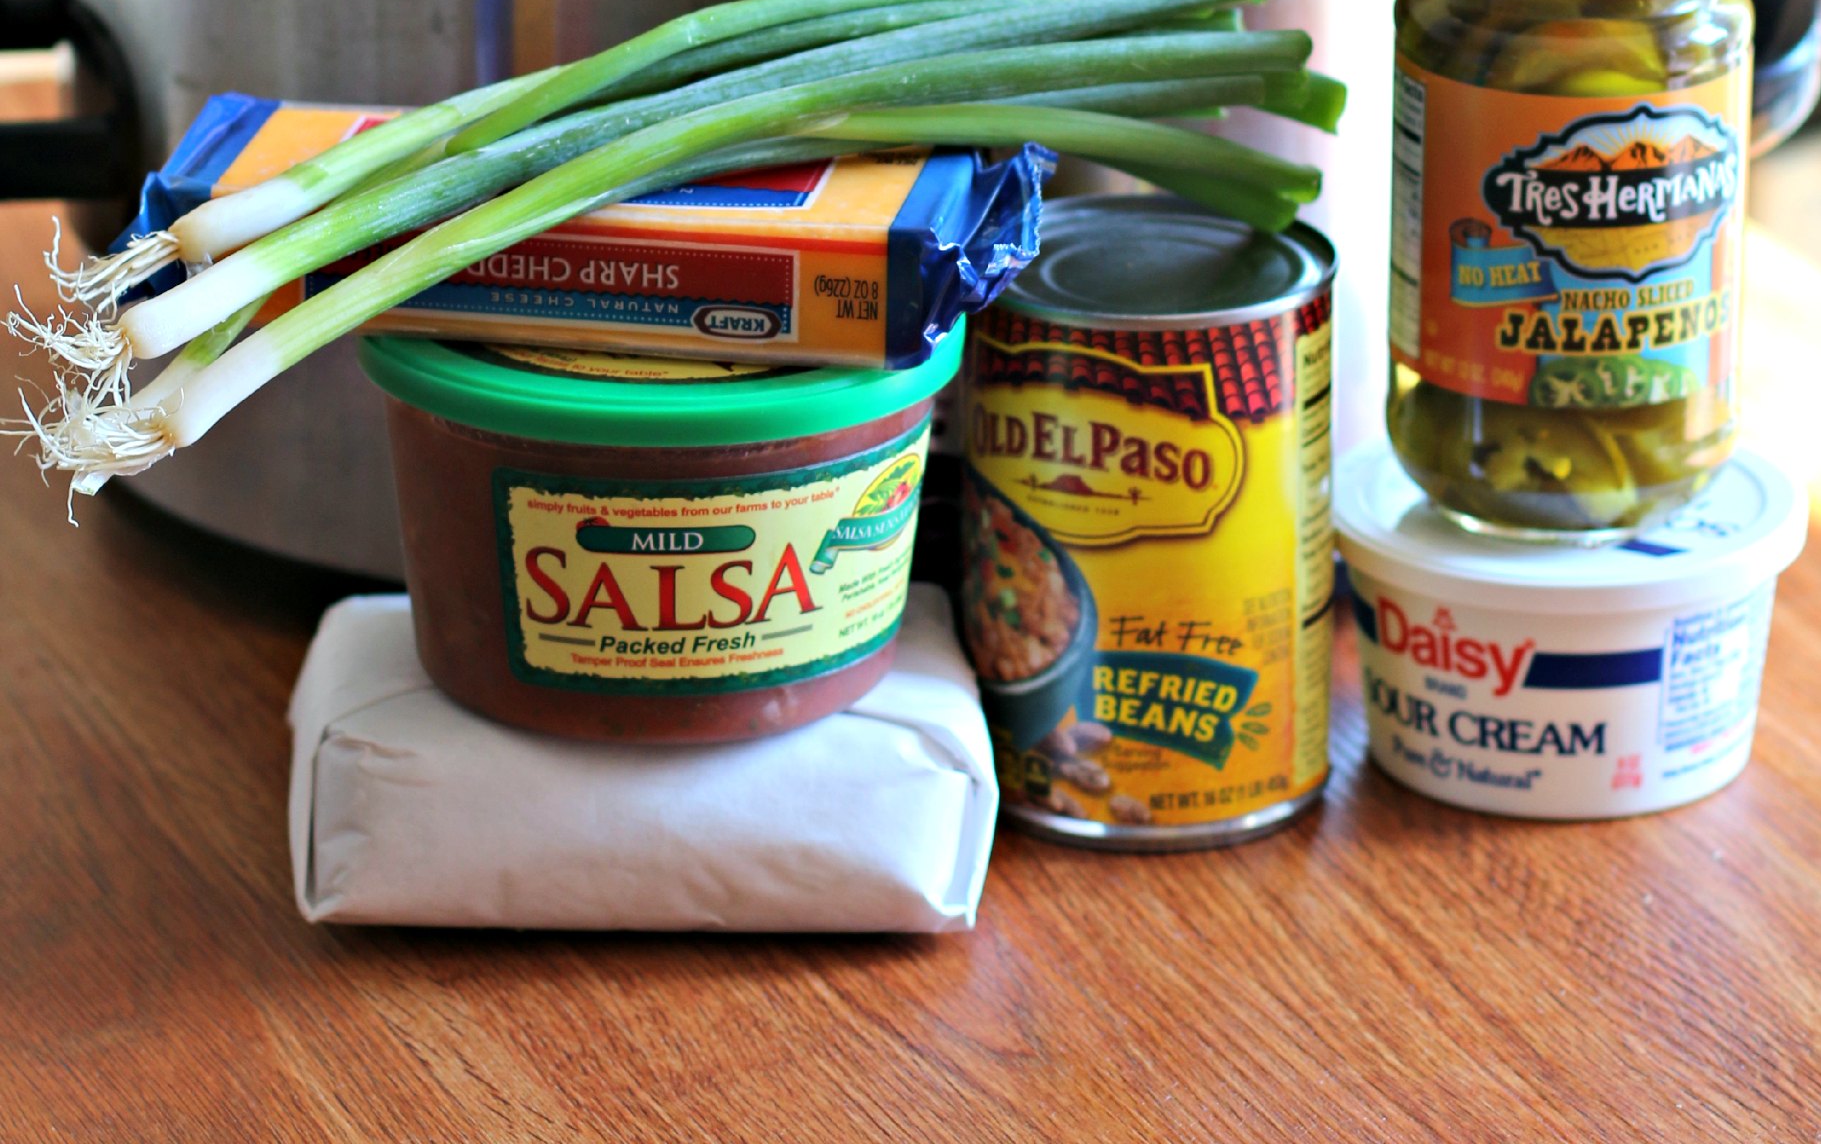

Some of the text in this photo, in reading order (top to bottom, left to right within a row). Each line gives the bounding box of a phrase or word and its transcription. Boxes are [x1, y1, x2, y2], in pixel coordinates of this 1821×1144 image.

[467, 254, 679, 289] CHEDD SHARP
[1457, 260, 1543, 288] NO HEAT
[814, 275, 879, 299] (226g) OZ 8
[1560, 279, 1694, 311] NACHO SLICED
[491, 291, 679, 313] CHEESE NATURAL
[836, 300, 878, 320] WT NET
[709, 315, 765, 332] KRAFT
[527, 499, 564, 514] simply
[566, 503, 597, 516] fruits
[600, 505, 609, 516] &
[612, 506, 678, 519] vegetables
[681, 506, 709, 517] from
[712, 506, 733, 516] our
[736, 502, 768, 514] farms
[771, 499, 782, 510] to
[785, 496, 808, 510] your
[631, 532, 704, 551] MILD
[525, 543, 823, 632] SALSA
[600, 632, 756, 655] Packed Fresh
[1109, 615, 1167, 649] Fat
[1178, 620, 1243, 657] Free
[1377, 595, 1529, 698] Daisy
[570, 648, 784, 668] Tamper Proof Seal Ensures Freshness
[1093, 666, 1238, 714] REFRIED
[1094, 694, 1219, 743] BEANS
[1364, 667, 1439, 737] OUR
[1449, 711, 1607, 755] CREAM
[1150, 793, 1174, 810] NET
